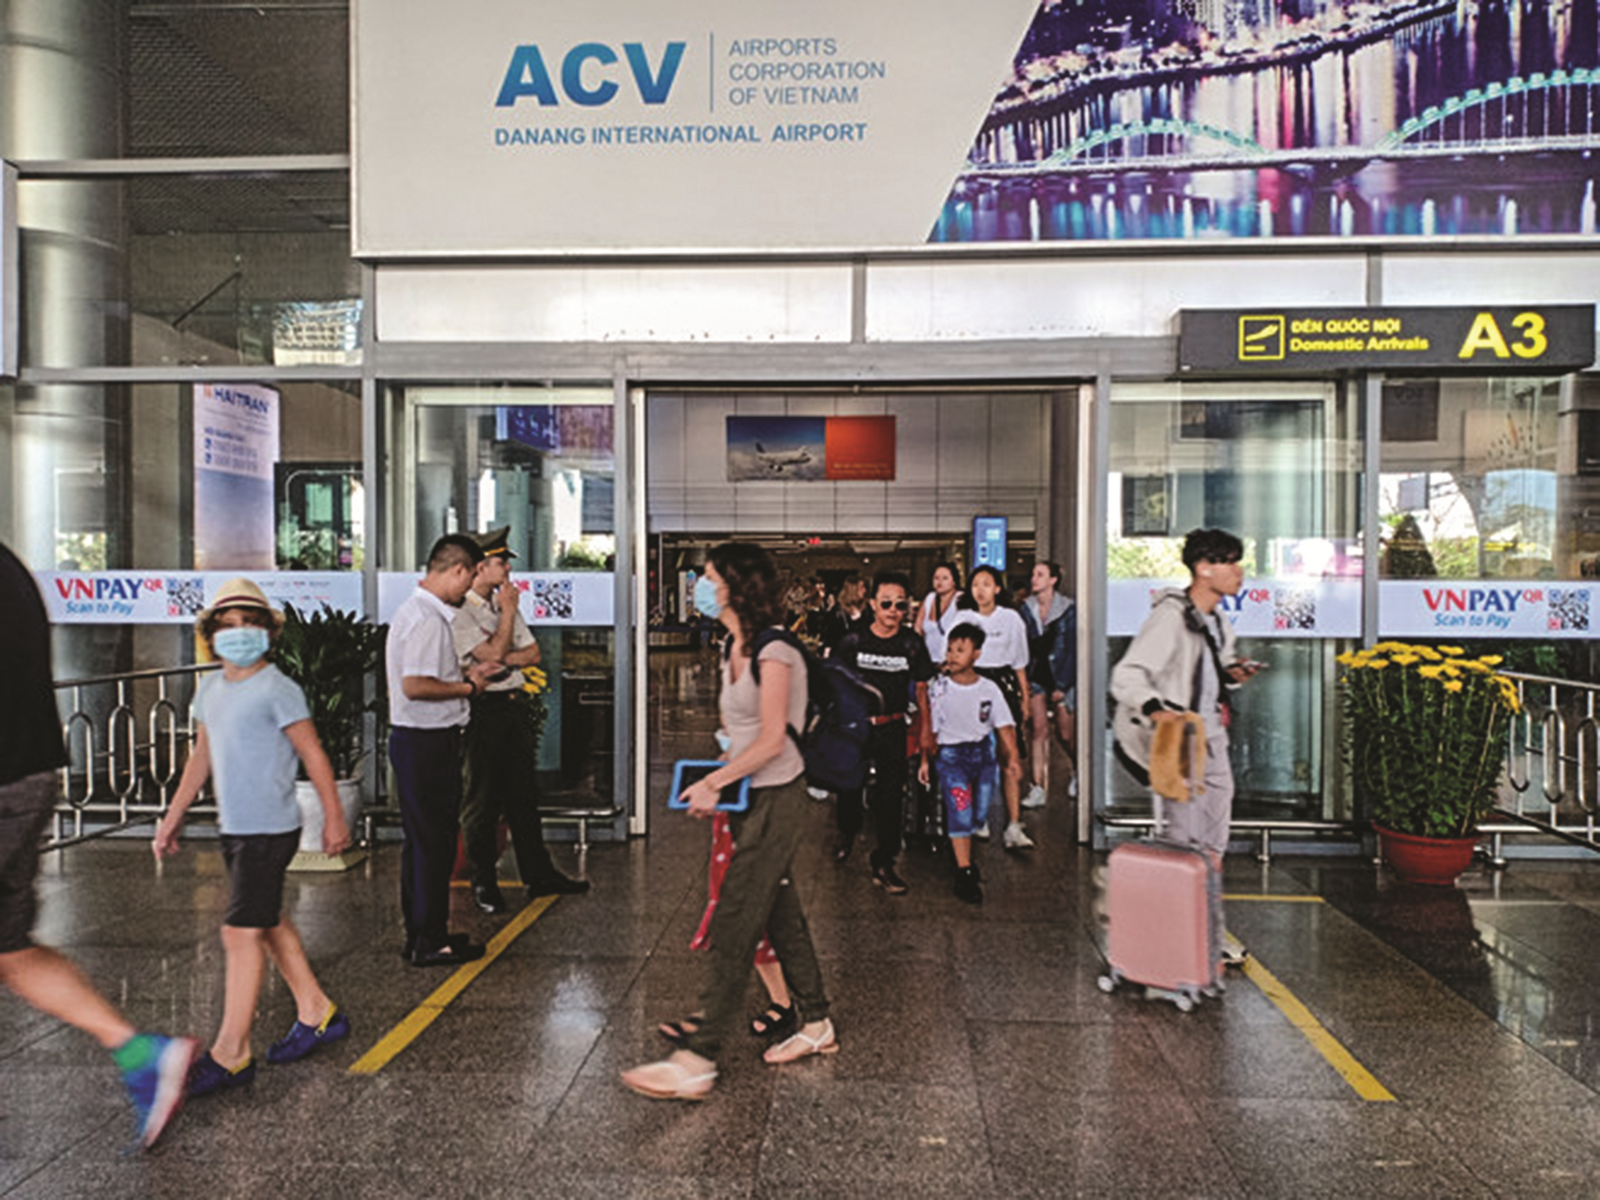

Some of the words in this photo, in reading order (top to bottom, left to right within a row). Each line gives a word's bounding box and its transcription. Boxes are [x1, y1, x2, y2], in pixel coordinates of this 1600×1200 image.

[729, 38, 838, 57] AIRPORTS
[495, 42, 687, 107] ACV
[729, 61, 886, 82] CORPORATION
[729, 87, 757, 106] OF
[764, 86, 859, 105] VIETNAM
[495, 127, 586, 146] DANANG
[592, 125, 761, 144] INTERNATIONAL
[772, 123, 868, 142] AIRPORT
[1290, 338, 1364, 352] Domestic
[1367, 336, 1430, 350] Arrivals
[1457, 312, 1548, 358] A3
[66, 601, 94, 614] Scan
[97, 602, 110, 613] to
[112, 601, 134, 616] Pay
[1434, 613, 1465, 627] Scan
[1469, 614, 1483, 627] to
[1486, 614, 1511, 629] Pay
